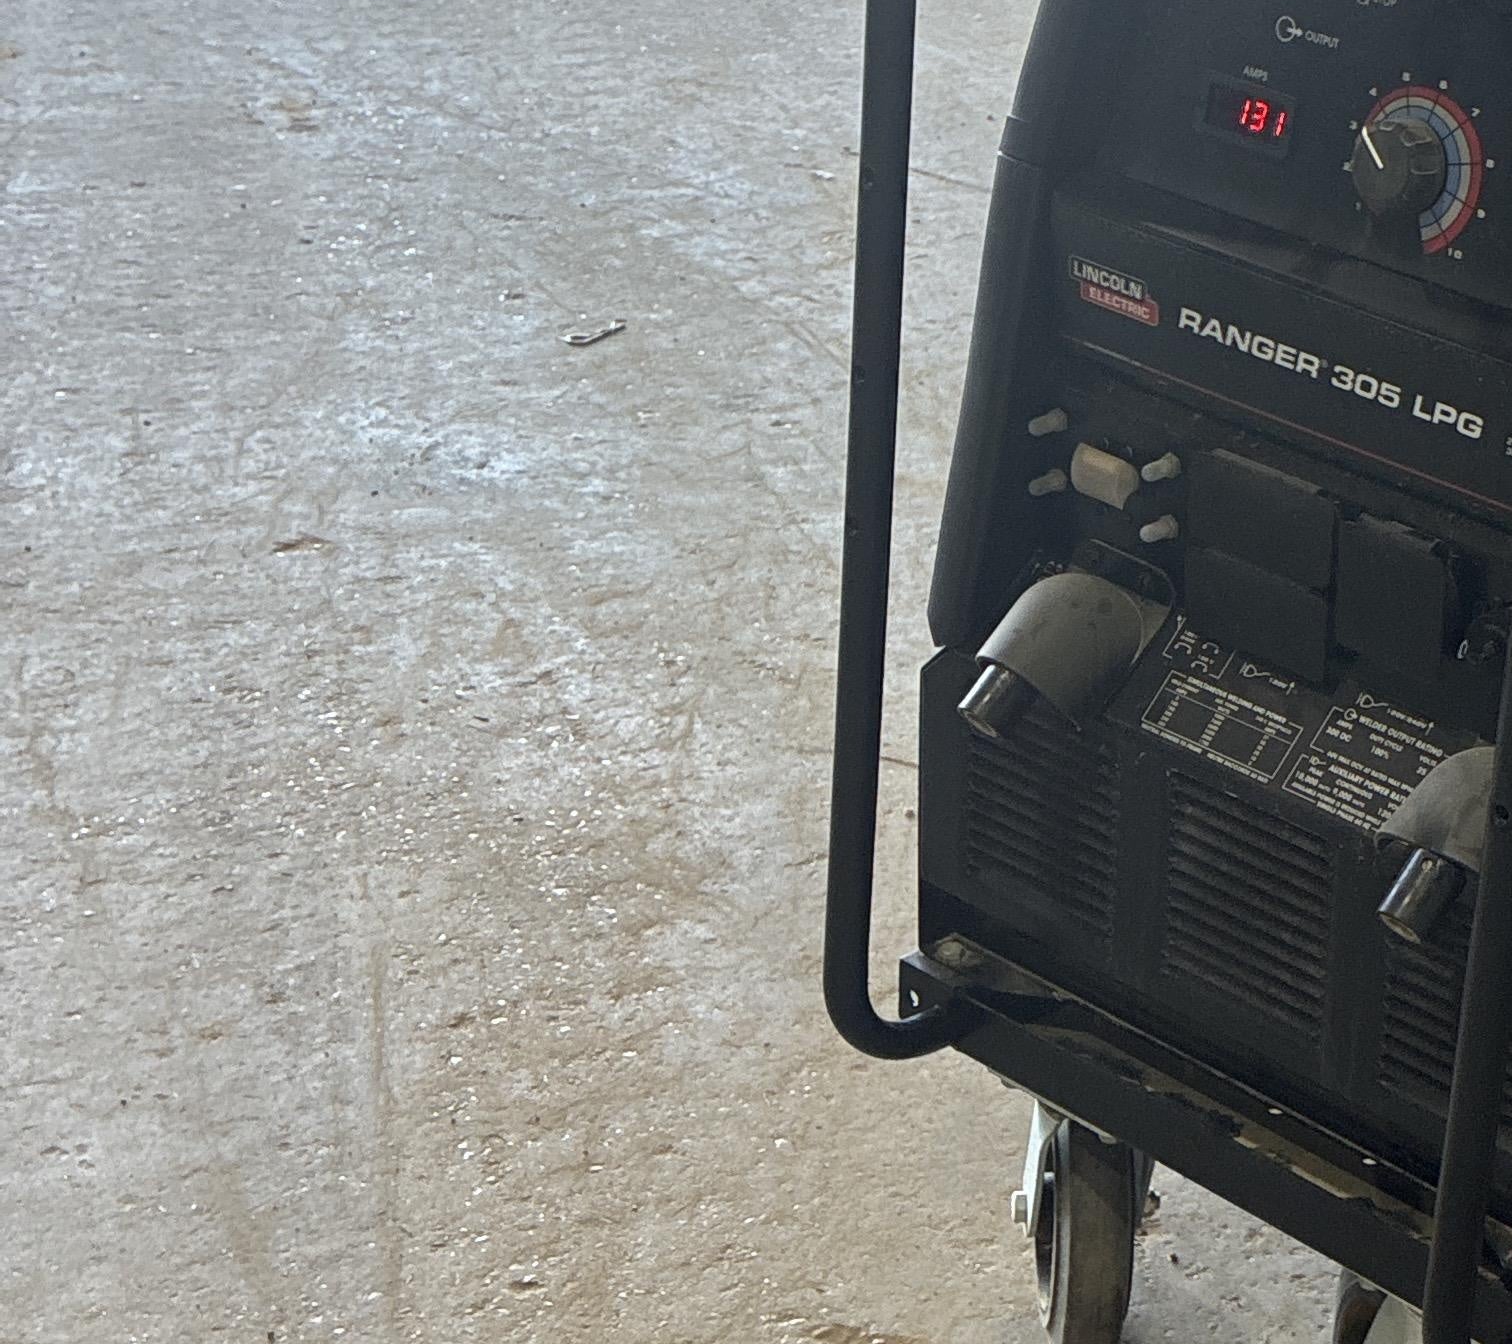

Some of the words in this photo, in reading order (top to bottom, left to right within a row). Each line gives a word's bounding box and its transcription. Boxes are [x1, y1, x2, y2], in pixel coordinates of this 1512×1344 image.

[1304, 29, 1340, 49] OUTPUT
[1243, 64, 1268, 82] AMPS
[1239, 99, 1287, 136] 131
[1073, 260, 1143, 299] LINCOLN
[1089, 287, 1151, 319] ELECTRIC
[1178, 307, 1321, 378] RANGER
[1330, 365, 1401, 408] 305
[1412, 394, 1484, 439] LPG
[1340, 731, 1352, 742] DC
[1359, 715, 1387, 733] WELDER
[1387, 728, 1416, 745] OUTPUT
[1415, 740, 1443, 757] RATING
